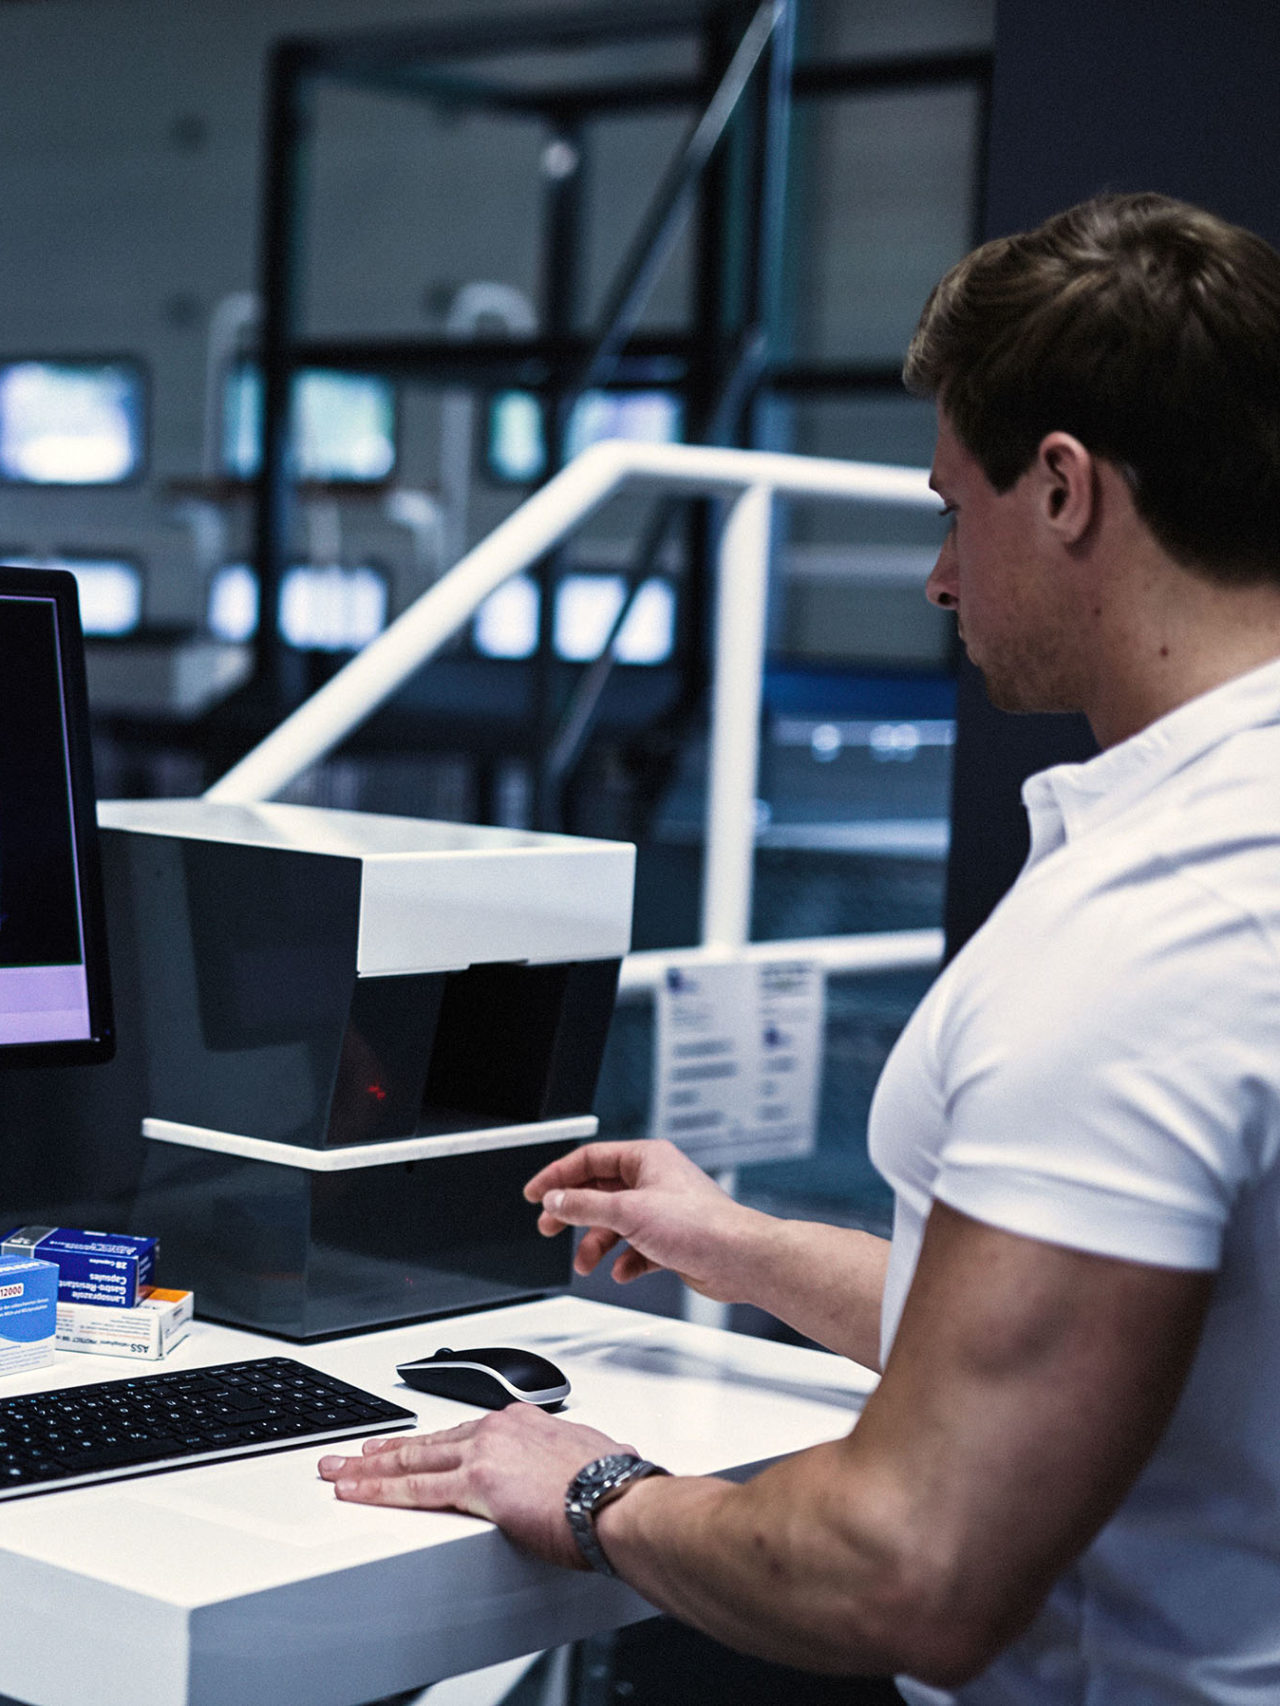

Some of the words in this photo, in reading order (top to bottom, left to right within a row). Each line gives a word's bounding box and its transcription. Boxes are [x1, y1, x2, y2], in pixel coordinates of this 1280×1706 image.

[89, 1273, 128, 1286] Capsules
[0, 1285, 22, 1298] 12000
[71, 1291, 126, 1305] Lansoprazole
